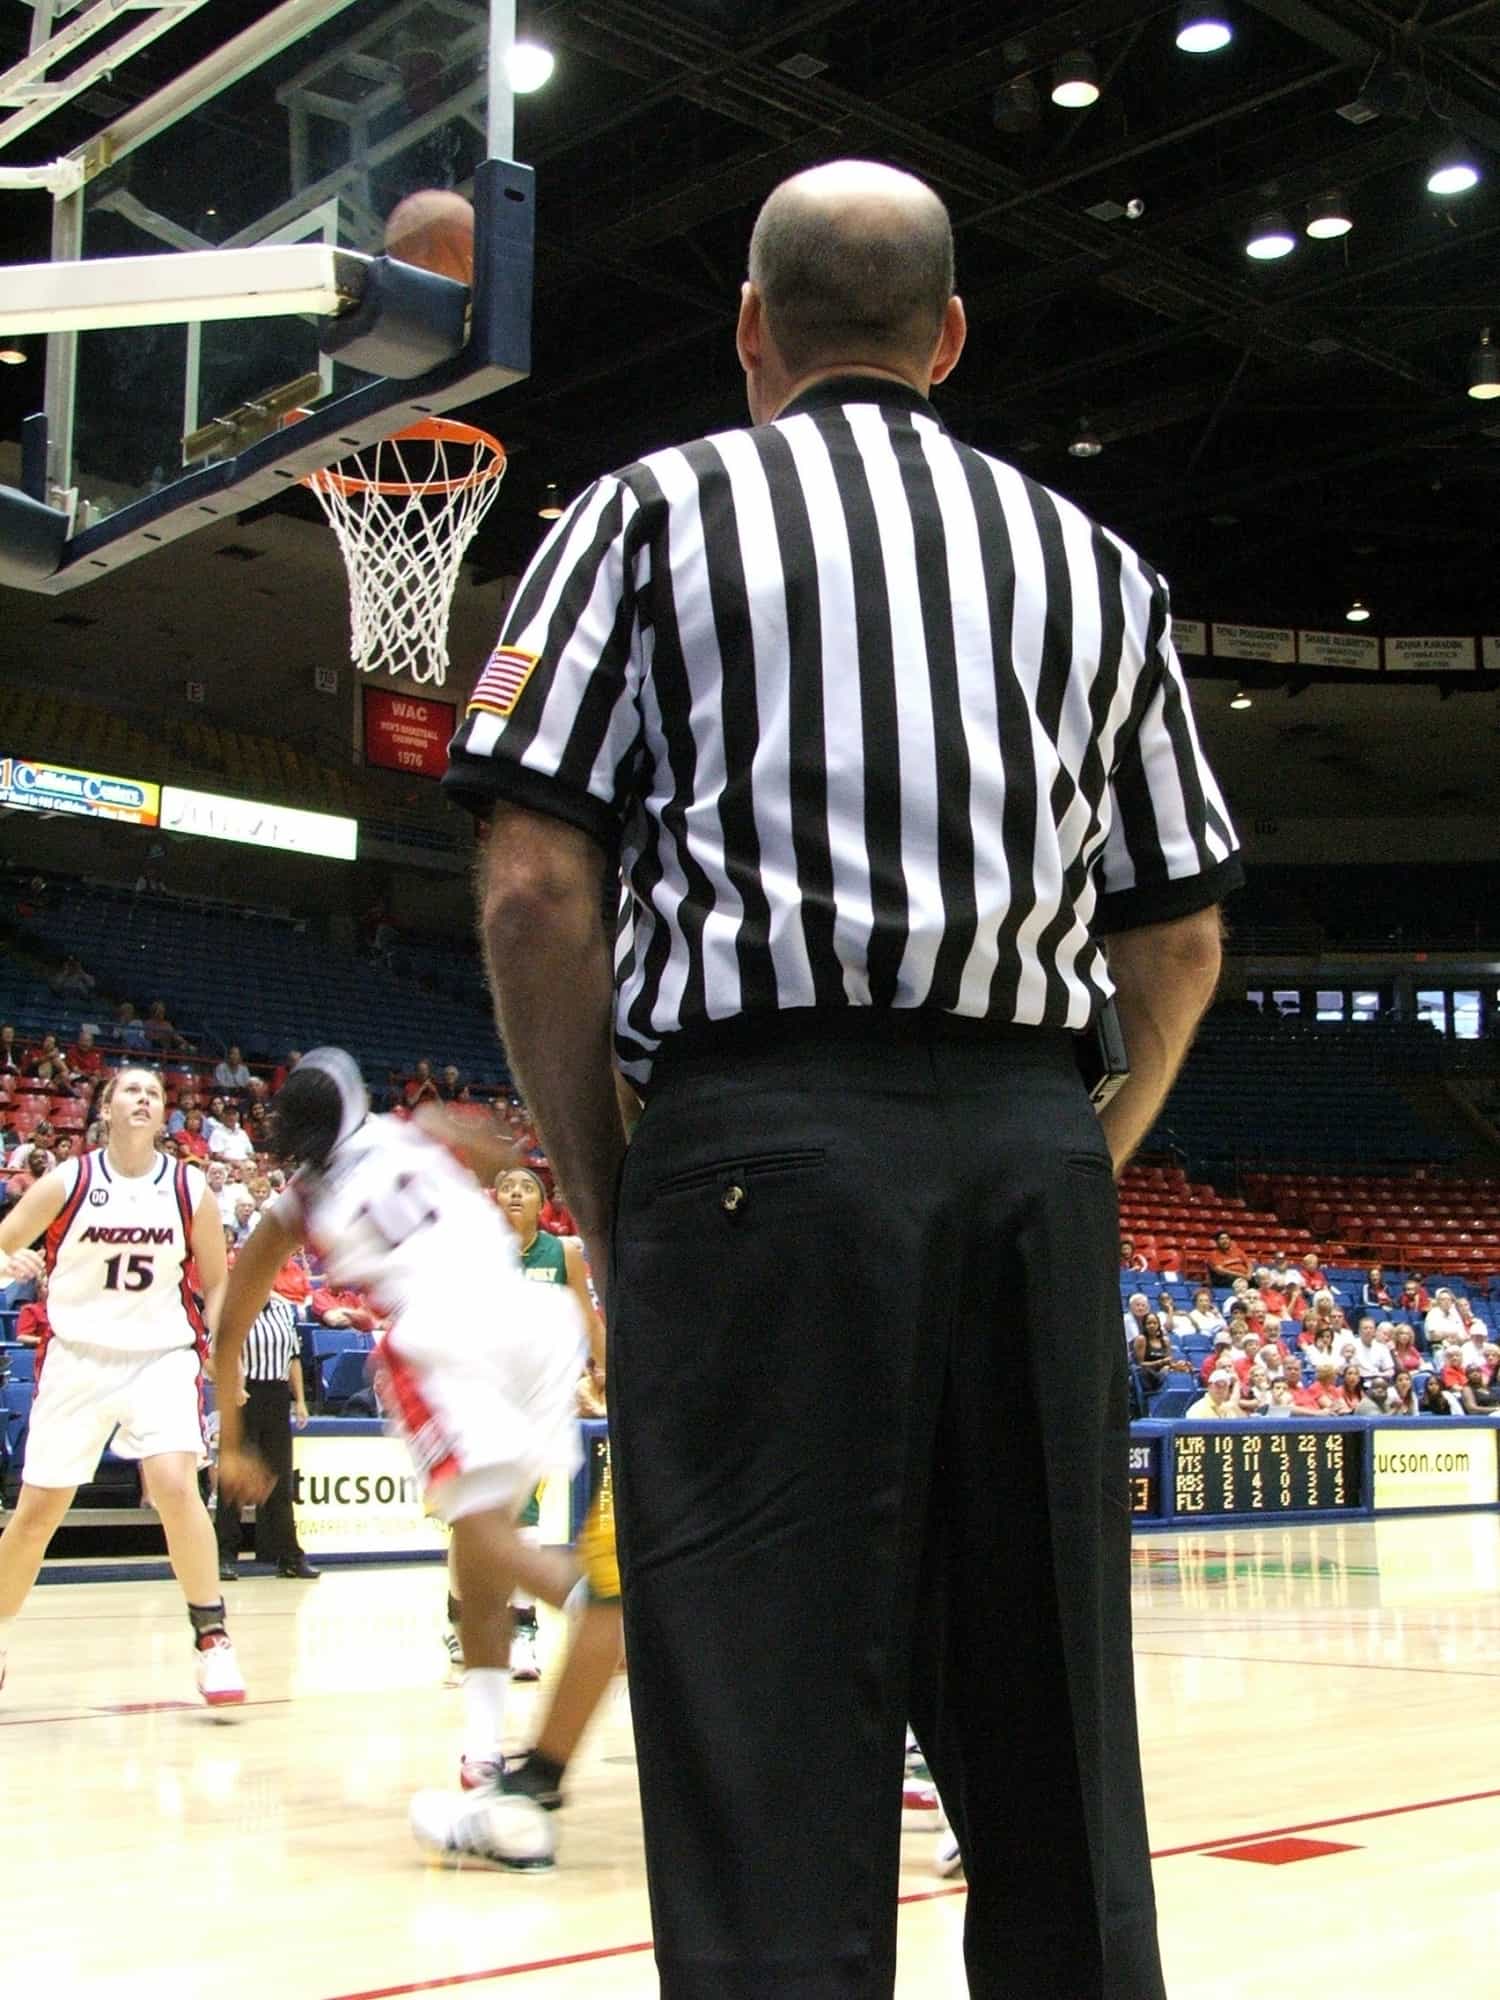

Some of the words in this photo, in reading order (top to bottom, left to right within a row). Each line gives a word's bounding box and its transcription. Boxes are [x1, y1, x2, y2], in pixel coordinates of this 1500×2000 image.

[391, 701, 428, 722] WAC
[397, 751, 424, 768] 1976
[79, 1226, 174, 1244] ARIZONA
[103, 1252, 154, 1292] 15
[1214, 1436, 1233, 1453] 10
[1242, 1435, 1262, 1453] 20
[1270, 1435, 1286, 1452] 21
[1298, 1435, 1317, 1452] 22
[1325, 1434, 1343, 1451] 42
[1177, 1455, 1202, 1473] PTS
[1222, 1454, 1233, 1472] 2
[1244, 1454, 1259, 1471] 11
[1280, 1453, 1290, 1470] 3
[1307, 1453, 1317, 1469] 6
[1327, 1452, 1343, 1469] 15
[1176, 1474, 1205, 1492] RBS
[1222, 1473, 1234, 1490] 2
[1252, 1472, 1262, 1488] 4
[1280, 1471, 1290, 1488] 0
[1307, 1470, 1318, 1487] 3
[1334, 1470, 1344, 1486] 4
[1176, 1493, 1205, 1511] FLS
[1223, 1492, 1234, 1509] 2
[1252, 1490, 1263, 1508] 2
[1280, 1489, 1291, 1506] 0
[1307, 1488, 1318, 1505] 2
[1334, 1487, 1345, 1504] 2
